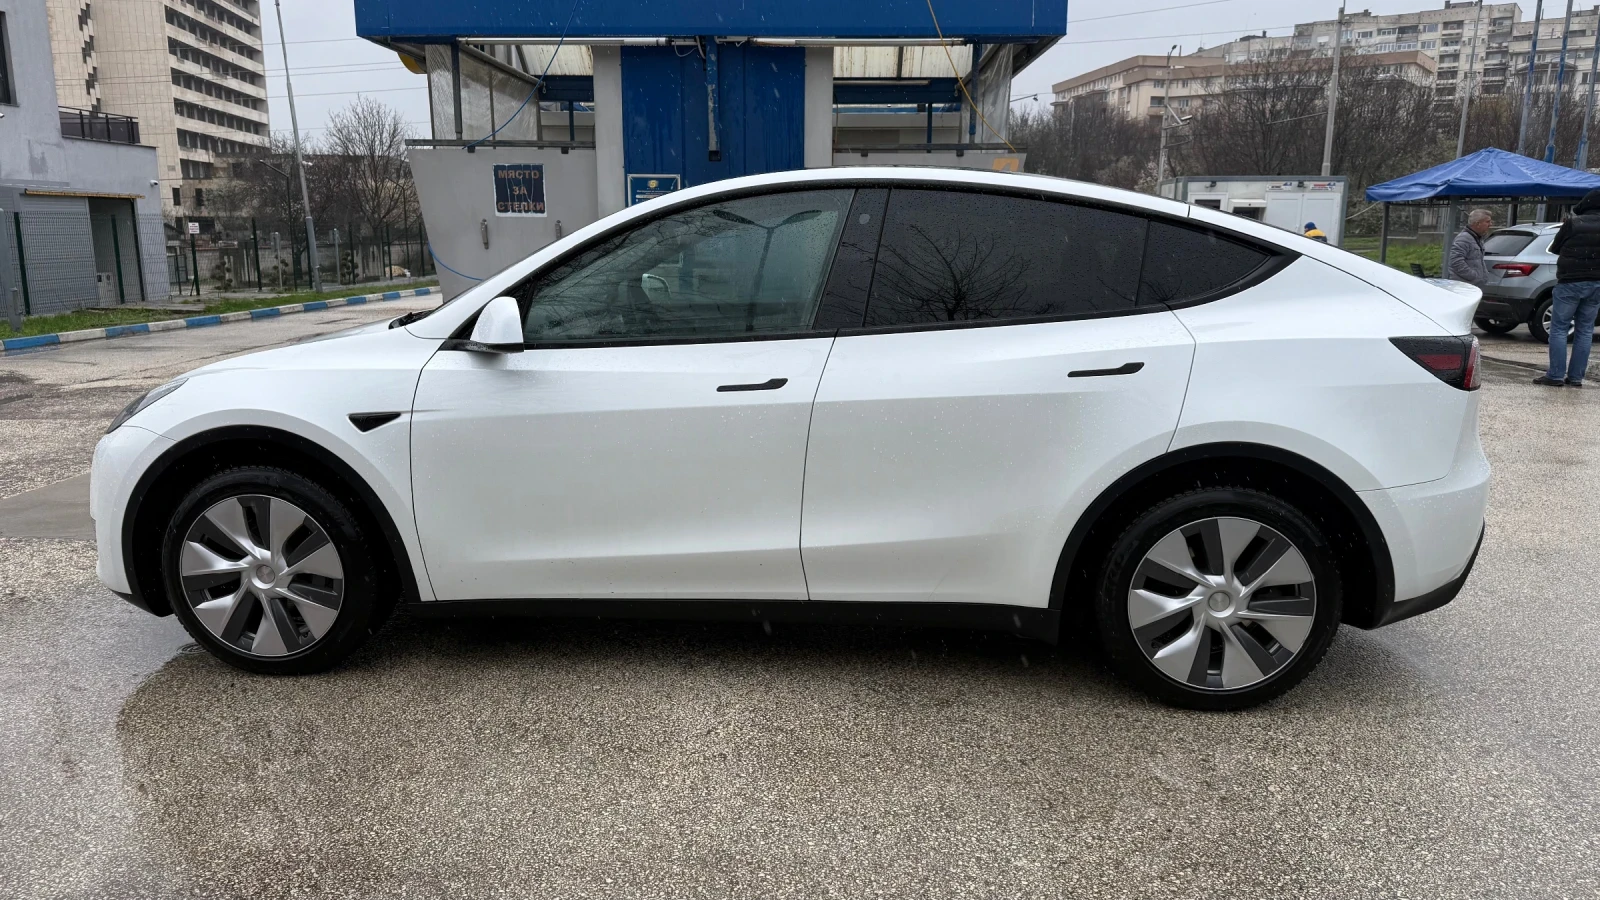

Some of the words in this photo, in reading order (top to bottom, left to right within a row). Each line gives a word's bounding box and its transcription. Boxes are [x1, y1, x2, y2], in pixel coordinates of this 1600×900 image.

[498, 170, 540, 179] МЯСТО
[512, 186, 528, 195] ЗА
[497, 201, 545, 211] СТЕЛКИ
